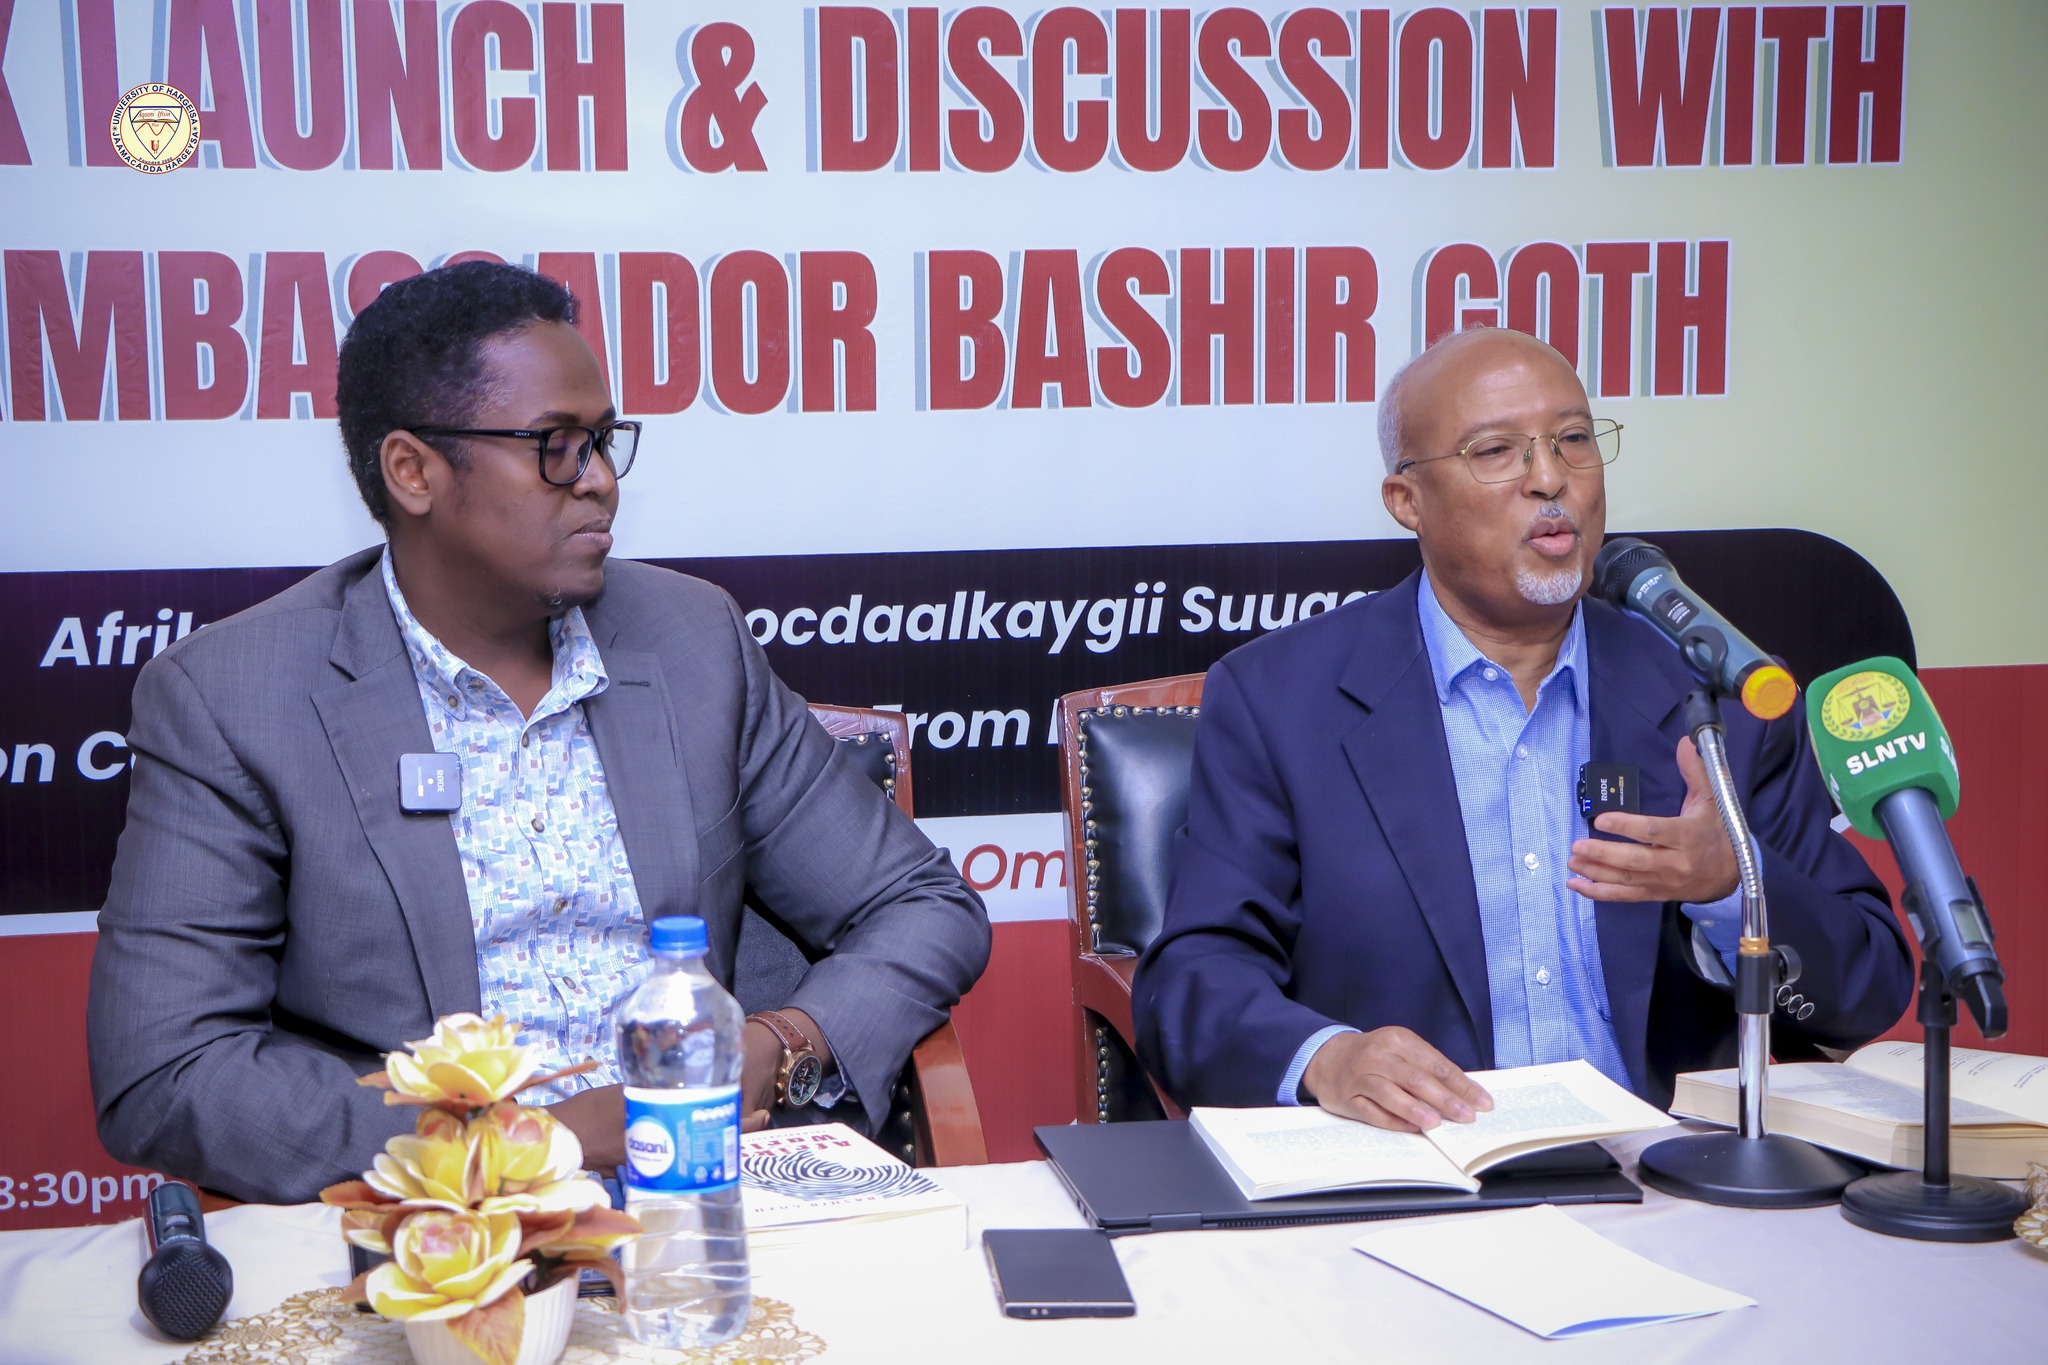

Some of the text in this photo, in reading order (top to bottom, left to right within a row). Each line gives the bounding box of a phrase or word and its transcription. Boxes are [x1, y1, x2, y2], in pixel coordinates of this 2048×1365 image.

[78, 0, 629, 172] LAUNCH
[681, 22, 768, 173] &
[819, 6, 1557, 173] DISCUSSION
[1603, 4, 1905, 167] WITH
[929, 246, 1378, 411] BASHIR
[1426, 240, 1728, 397] GOTH
[873, 704, 1030, 749] rom
[1846, 732, 1926, 775] SLNTV
